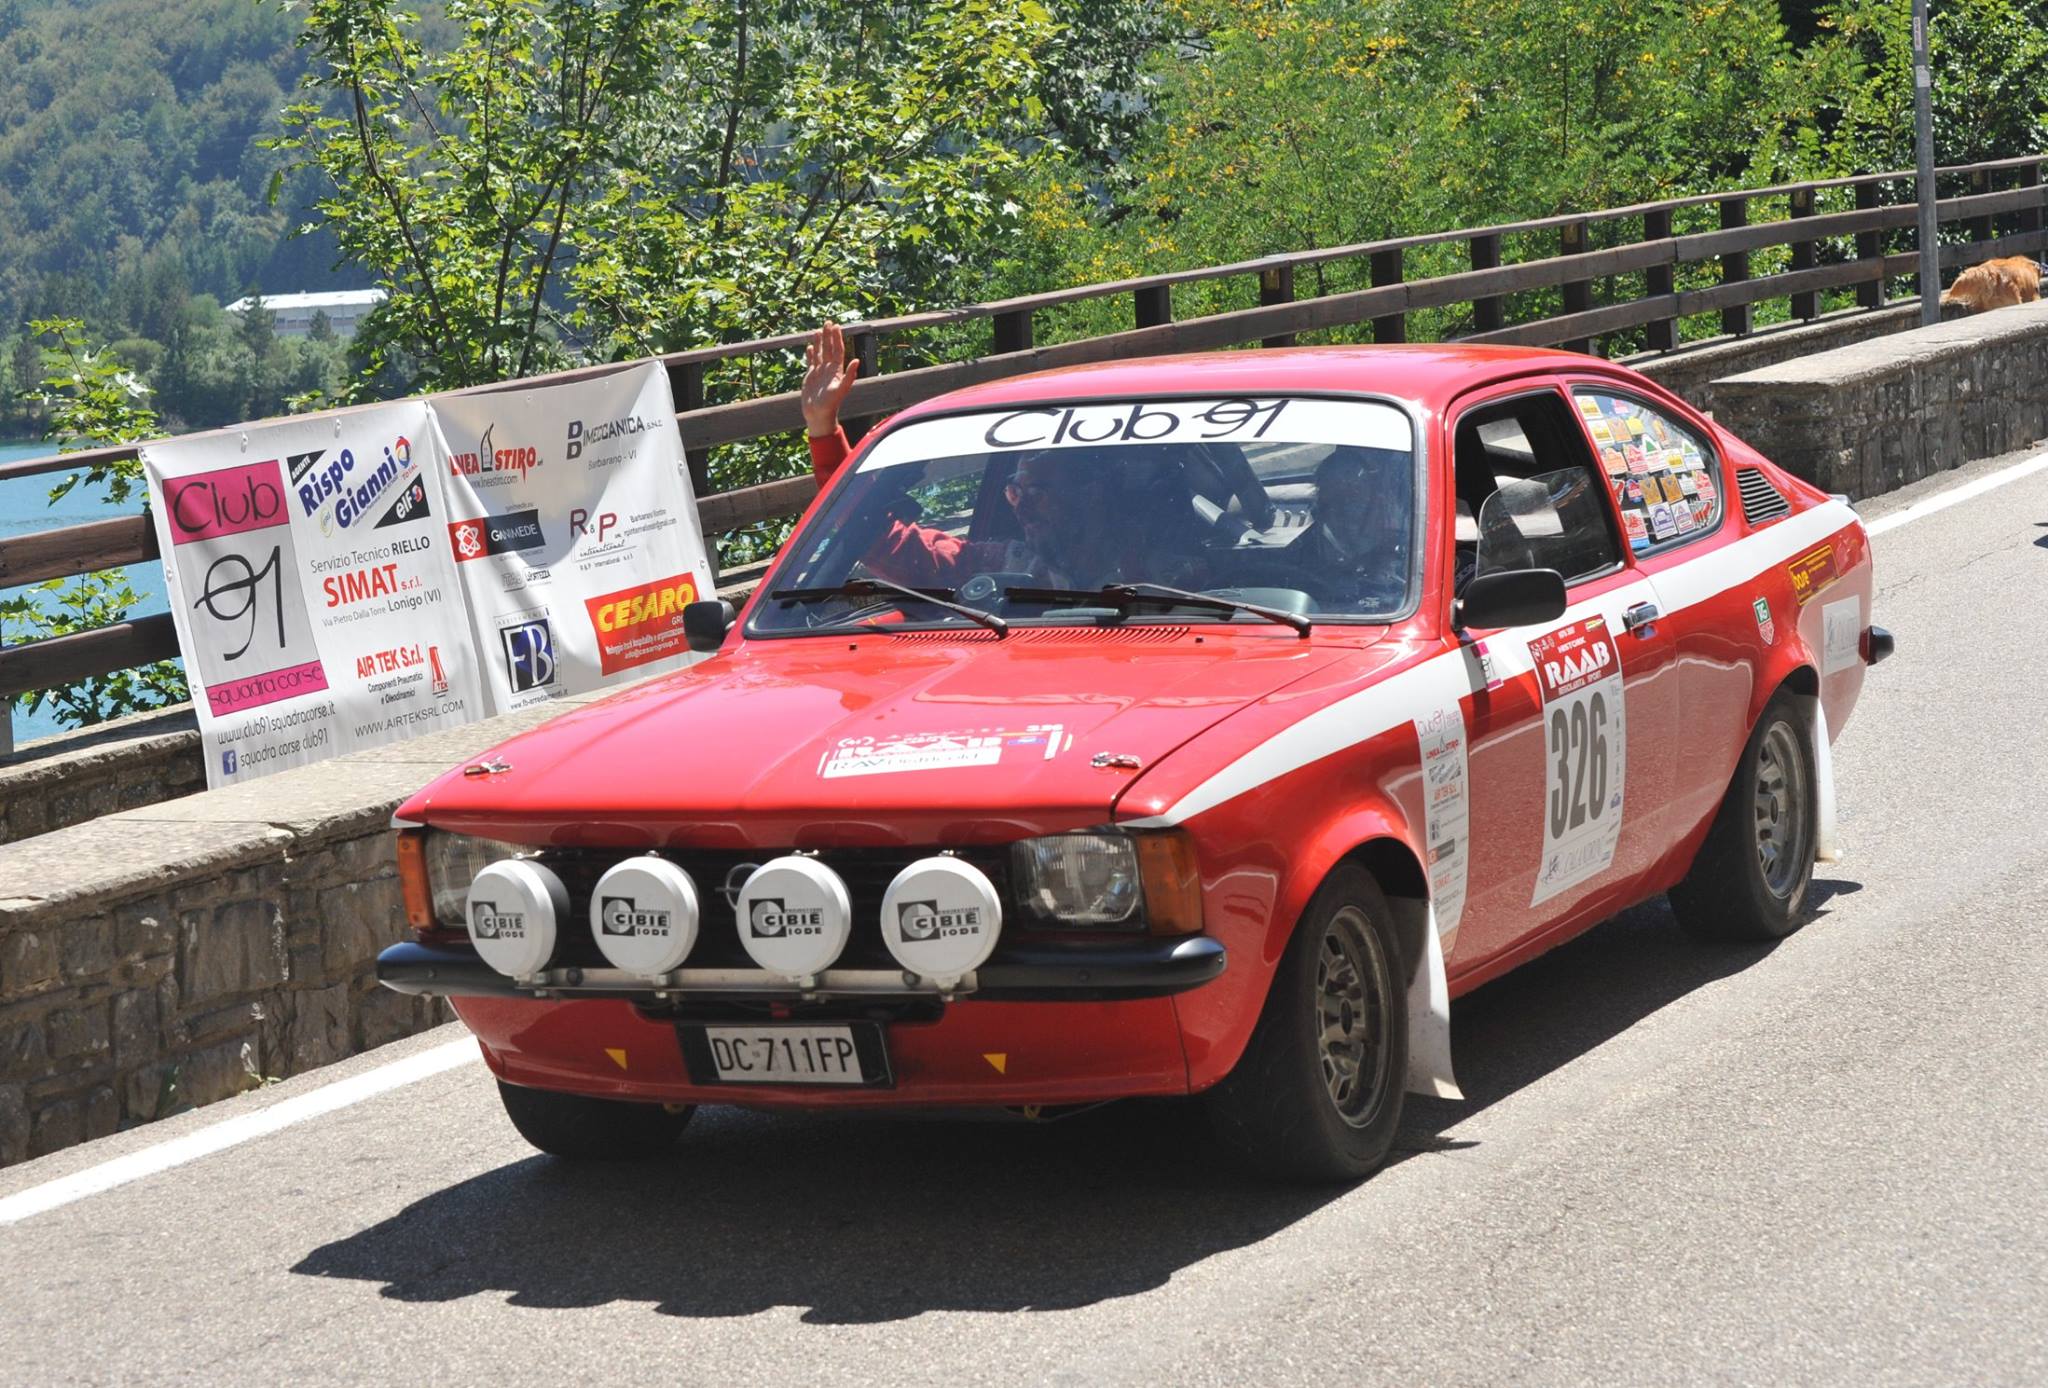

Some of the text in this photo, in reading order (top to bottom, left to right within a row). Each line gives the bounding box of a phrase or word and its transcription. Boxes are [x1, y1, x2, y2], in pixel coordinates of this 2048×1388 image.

[984, 399, 1289, 448] Club 91
[298, 448, 354, 518] Rispo
[494, 446, 537, 484] STIRO
[174, 476, 280, 533] Club
[335, 446, 398, 529] Gianni
[395, 490, 413, 519] elf
[570, 508, 588, 540] R
[598, 512, 617, 542] P
[310, 536, 431, 574] Servizio Tecnico RIELLO
[193, 546, 286, 661] 91
[323, 563, 398, 608] SIMAT
[388, 594, 423, 612] Lonigo
[424, 588, 441, 605] (VI)
[597, 583, 694, 632] CESARO
[356, 654, 376, 679] AIR
[375, 649, 400, 673] TEK
[1544, 641, 1611, 689] RAAB
[208, 665, 323, 706] squadra corse
[217, 700, 336, 745] www.club91squadracorse.it
[355, 699, 464, 737] WWW.AIRTEKSRL.COM
[240, 744, 277, 769] squadra
[278, 738, 301, 756] corse
[302, 727, 329, 752] club91
[1551, 691, 1607, 839] 326
[637, 928, 668, 936] IODE
[788, 927, 822, 935] IODE
[942, 926, 979, 937] IODE
